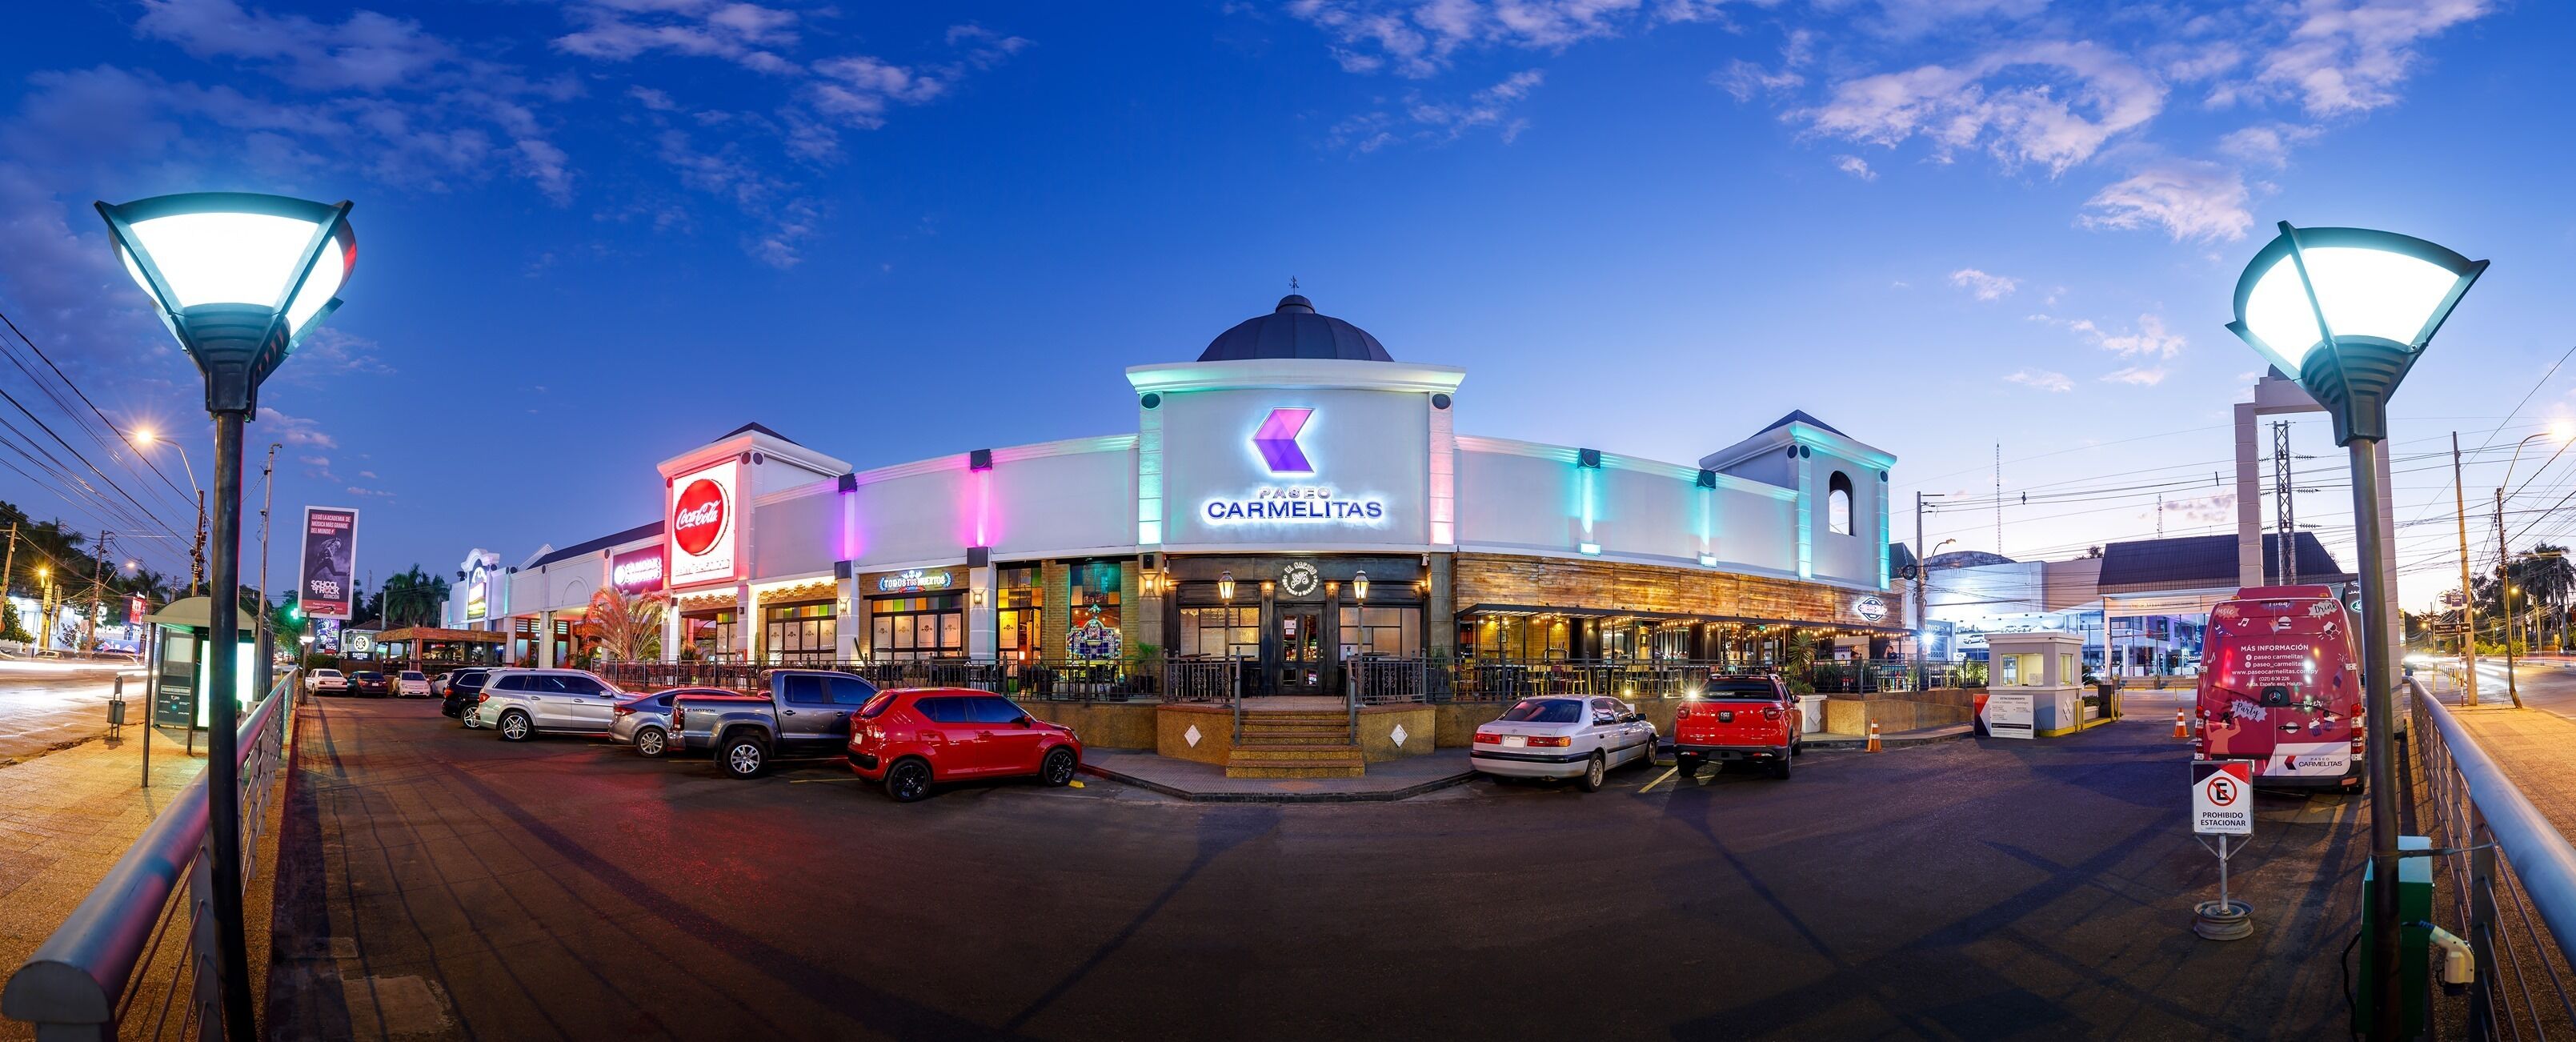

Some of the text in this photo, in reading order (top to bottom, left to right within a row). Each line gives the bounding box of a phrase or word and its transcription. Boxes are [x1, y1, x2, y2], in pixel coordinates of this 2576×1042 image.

[1259, 487, 1332, 499] PASEO
[675, 499, 722, 531] Coca-Cola
[1208, 501, 1383, 519] CARMELITAS
[310, 580, 338, 588] SCHOOL
[883, 579, 907, 588] TODOS
[907, 578, 917, 587] TUS
[2314, 603, 2337, 614] Drink
[2258, 643, 2309, 651] INFORMACIÓN
[2237, 702, 2260, 719] Party
